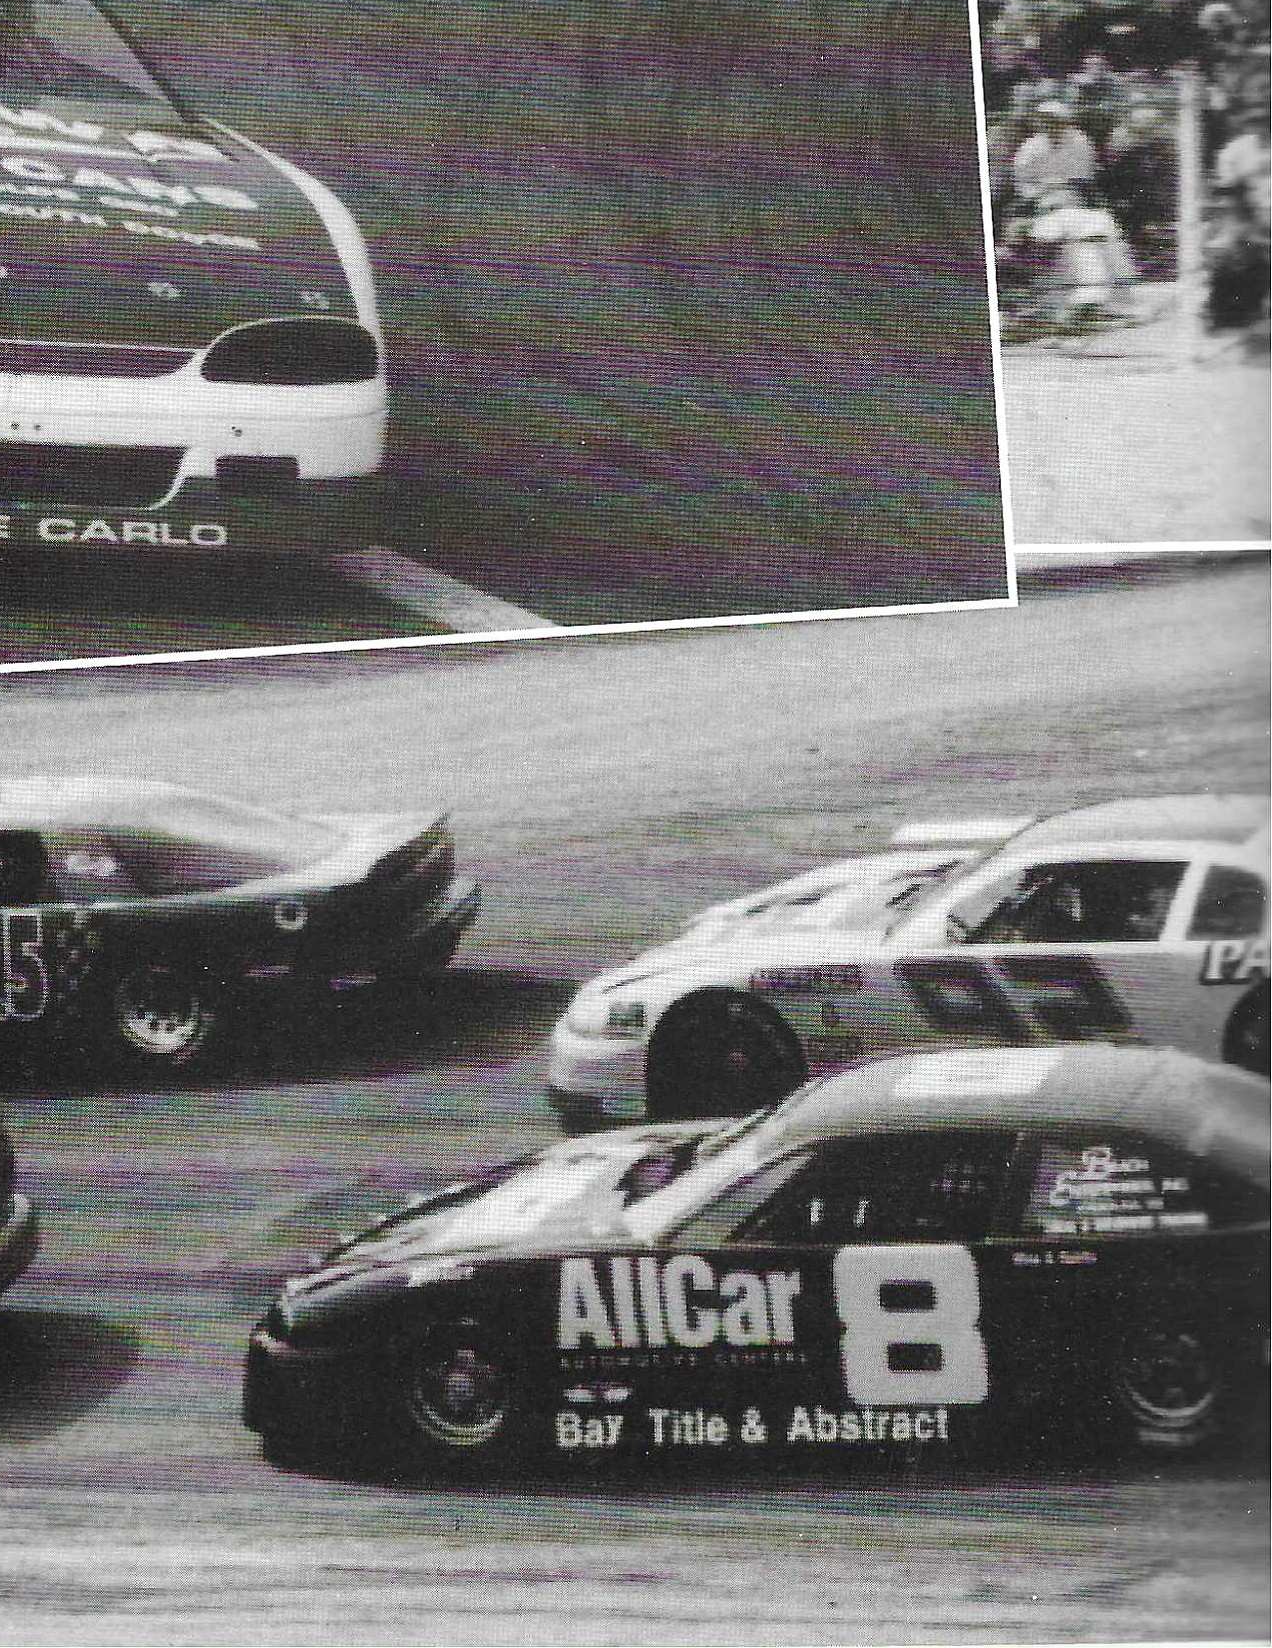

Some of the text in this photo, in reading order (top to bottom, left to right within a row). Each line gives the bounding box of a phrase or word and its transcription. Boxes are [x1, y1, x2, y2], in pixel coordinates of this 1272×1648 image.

[37, 513, 229, 548] CARLO
[556, 1253, 803, 1351] AllCar
[832, 1244, 990, 1406] 8
[555, 1403, 949, 1449] Bay Title & Abstract
